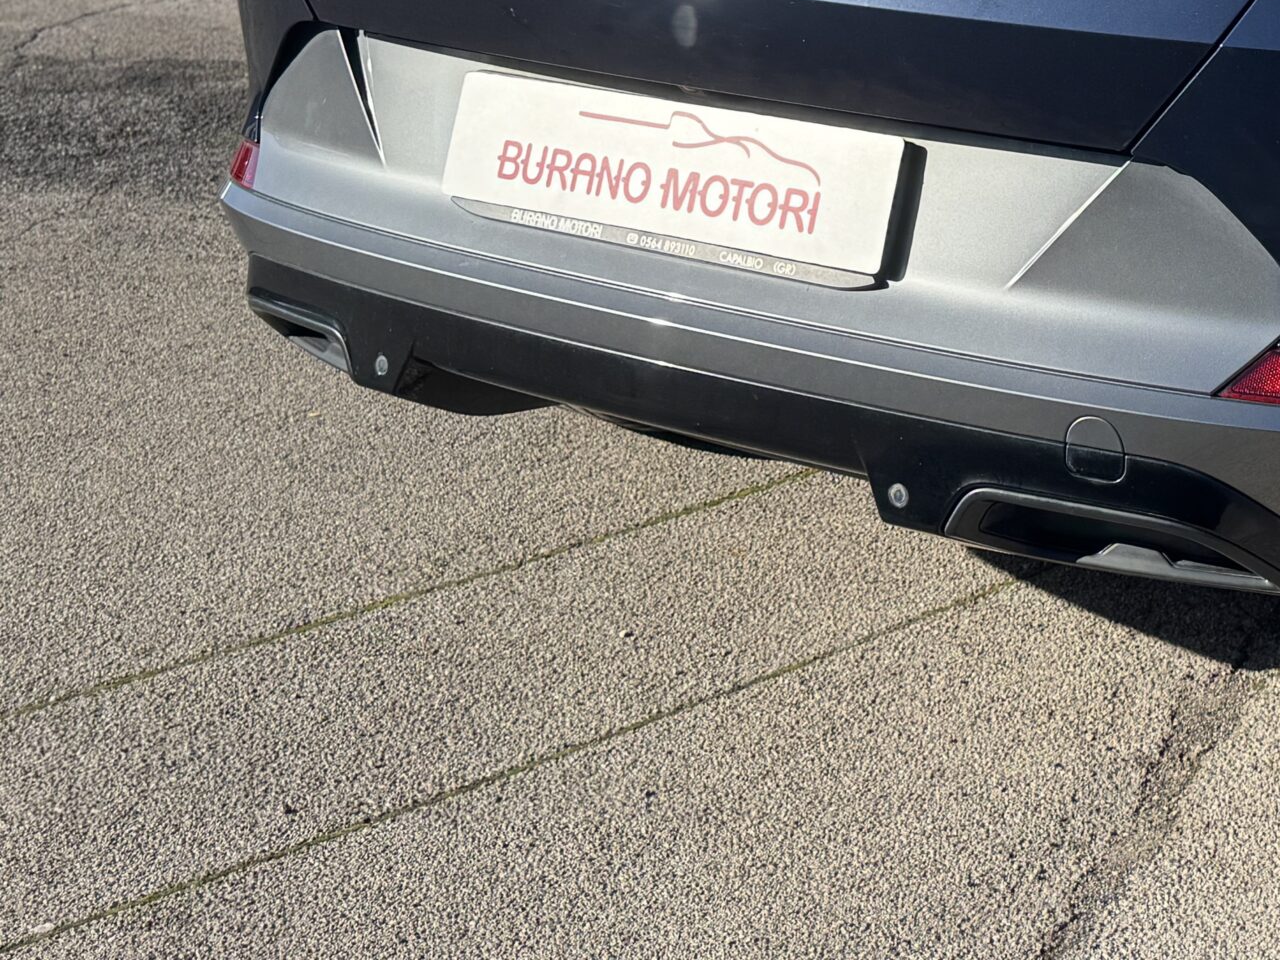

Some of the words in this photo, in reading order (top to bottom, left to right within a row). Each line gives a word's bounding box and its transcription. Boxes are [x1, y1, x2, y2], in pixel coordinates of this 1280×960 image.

[498, 140, 652, 204] BURANO
[660, 168, 822, 234] MOTORI
[510, 209, 556, 228] BURANO
[556, 217, 603, 238] MOTORI
[640, 237, 662, 250] 0564
[664, 240, 696, 256] 893110
[719, 251, 763, 269] CAPALBIO
[773, 262, 797, 276] (GR)
